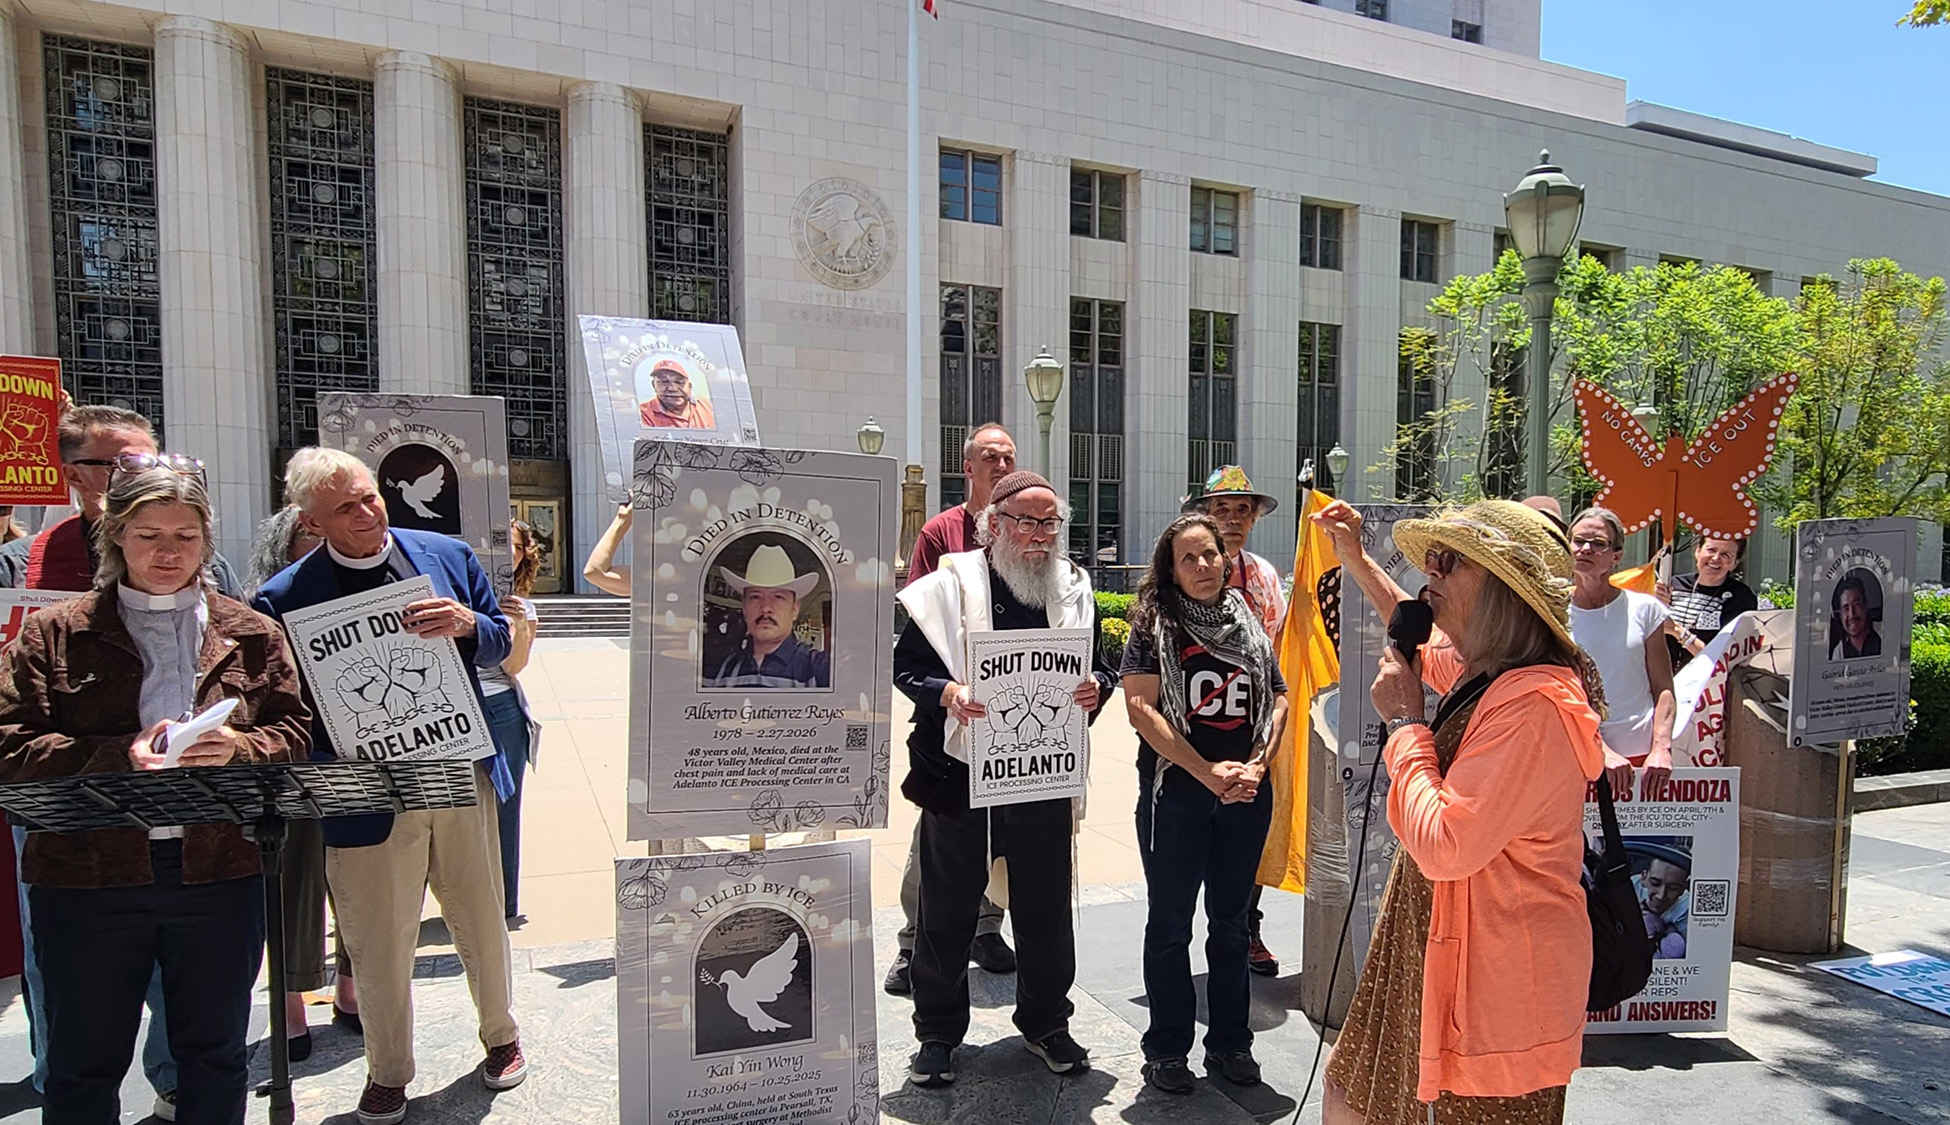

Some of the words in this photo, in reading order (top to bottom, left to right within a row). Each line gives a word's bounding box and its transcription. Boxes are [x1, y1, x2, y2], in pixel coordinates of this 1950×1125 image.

[366, 431, 389, 453] DIED
[389, 425, 403, 436] IN
[404, 423, 463, 456] DETENTION
[1601, 410, 1621, 431] NO
[1620, 429, 1656, 469] CAMPS
[1693, 441, 1724, 470] ICE
[1723, 408, 1756, 441] OUT
[0, 465, 59, 485] ANTO
[687, 519, 728, 557] DIED
[730, 508, 751, 524] IN
[757, 503, 849, 566] DETENTION
[1384, 550, 1404, 575] DIED
[1826, 558, 1843, 580] DIED
[1851, 548, 1889, 577] DETENTION
[309, 620, 363, 662] SHUT
[1743, 634, 1765, 657] IN
[980, 652, 1025, 681] SHUT
[1031, 651, 1082, 676] DOWN
[684, 702, 737, 720] Alberto
[740, 705, 802, 725] Gutierrez
[804, 704, 846, 726] Reyes
[355, 713, 471, 761] ADELANTO
[439, 737, 470, 753] CENTER
[712, 728, 743, 741] 1978
[757, 727, 818, 739] 2.27.2026
[684, 758, 714, 767] Victor
[717, 757, 746, 768] Valley
[749, 756, 786, 766] Medical
[788, 756, 819, 765] Center
[820, 756, 843, 766] after
[687, 748, 700, 756] 48
[703, 749, 729, 758] years
[731, 746, 749, 757] old,
[752, 746, 788, 756] Mexico,
[789, 745, 810, 755] died
[812, 746, 822, 754] at
[824, 745, 839, 754] the
[674, 769, 699, 778] chest
[702, 768, 724, 780] pain
[726, 767, 744, 776] and
[747, 767, 766, 776] lack
[769, 766, 779, 777] of
[780, 766, 816, 775] medical
[840, 766, 850, 774] at
[982, 752, 1076, 781] ADELANTO
[673, 779, 717, 789] Adelanto
[720, 778, 738, 787] ICE
[739, 776, 790, 787] Processing
[792, 776, 822, 785] Center
[824, 776, 834, 784] in
[836, 775, 850, 784] CA
[986, 781, 998, 790] ICE
[1000, 777, 1043, 789] PROCESSING
[1045, 774, 1070, 784] CENTER
[1629, 821, 1653, 829] AFTER
[1654, 821, 1695, 829] SURGERY!
[690, 882, 757, 920] KILLED
[763, 882, 785, 895] BY
[787, 886, 815, 909] ICE
[1648, 976, 1687, 986] SILENT!
[1672, 966, 1679, 975] &
[1682, 966, 1700, 975] WE
[1651, 987, 1679, 996] REPS
[1627, 1000, 1717, 1022] ANSWERS!
[706, 1063, 734, 1078] Kai
[737, 1060, 762, 1074] Yin
[766, 1054, 804, 1072] Wong
[686, 1082, 747, 1099] 11.30.1964
[761, 1070, 822, 1087] 10.25.2025
[668, 1109, 681, 1119] 63
[681, 1106, 706, 1118] years
[707, 1103, 724, 1113] old,
[727, 1099, 756, 1110] China,
[757, 1094, 776, 1105] held
[788, 1089, 813, 1100] South
[815, 1085, 838, 1095] Texas
[692, 1111, 738, 1125] processing
[740, 1107, 767, 1118] center
[769, 1105, 778, 1113] in
[780, 1100, 816, 1113] Pearsall,
[819, 1096, 834, 1105] TX,
[779, 1113, 788, 1121] at
[790, 1106, 832, 1121] Methodist
